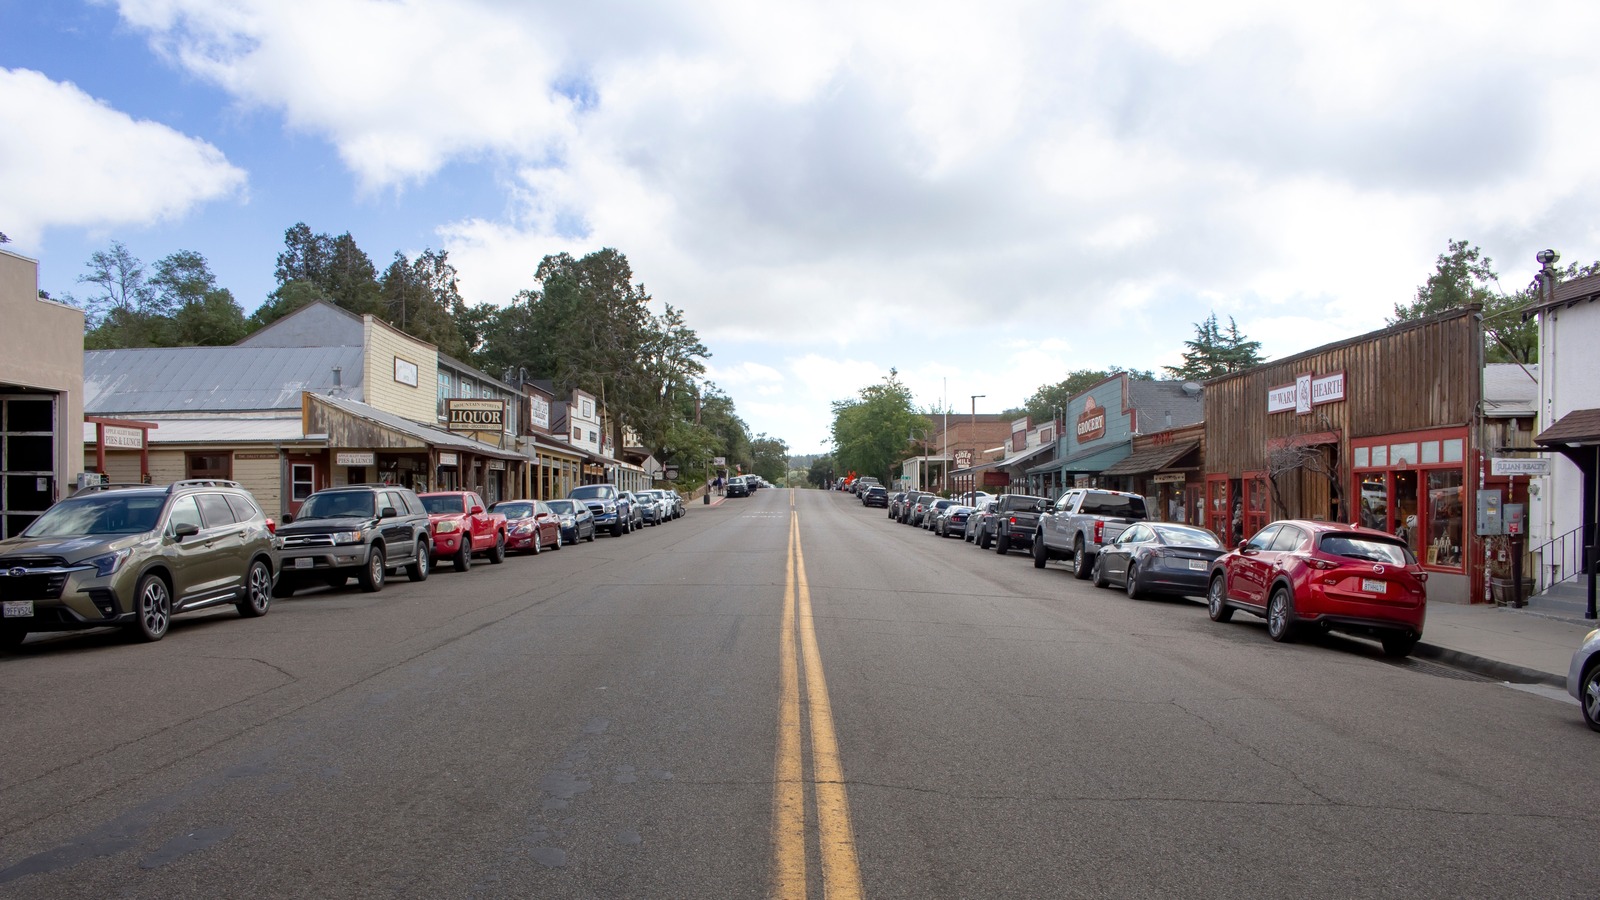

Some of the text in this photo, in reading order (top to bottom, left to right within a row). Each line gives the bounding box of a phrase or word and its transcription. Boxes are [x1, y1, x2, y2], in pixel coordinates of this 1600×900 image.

[1277, 389, 1297, 405] WARM
[1313, 379, 1343, 398] HEARTH
[451, 410, 502, 424] LIQUOR
[1077, 414, 1103, 436] GROCERY
[105, 435, 141, 447] PIES & LUNCH
[955, 450, 972, 460] CIDER
[1497, 463, 1520, 471] JULIAN
